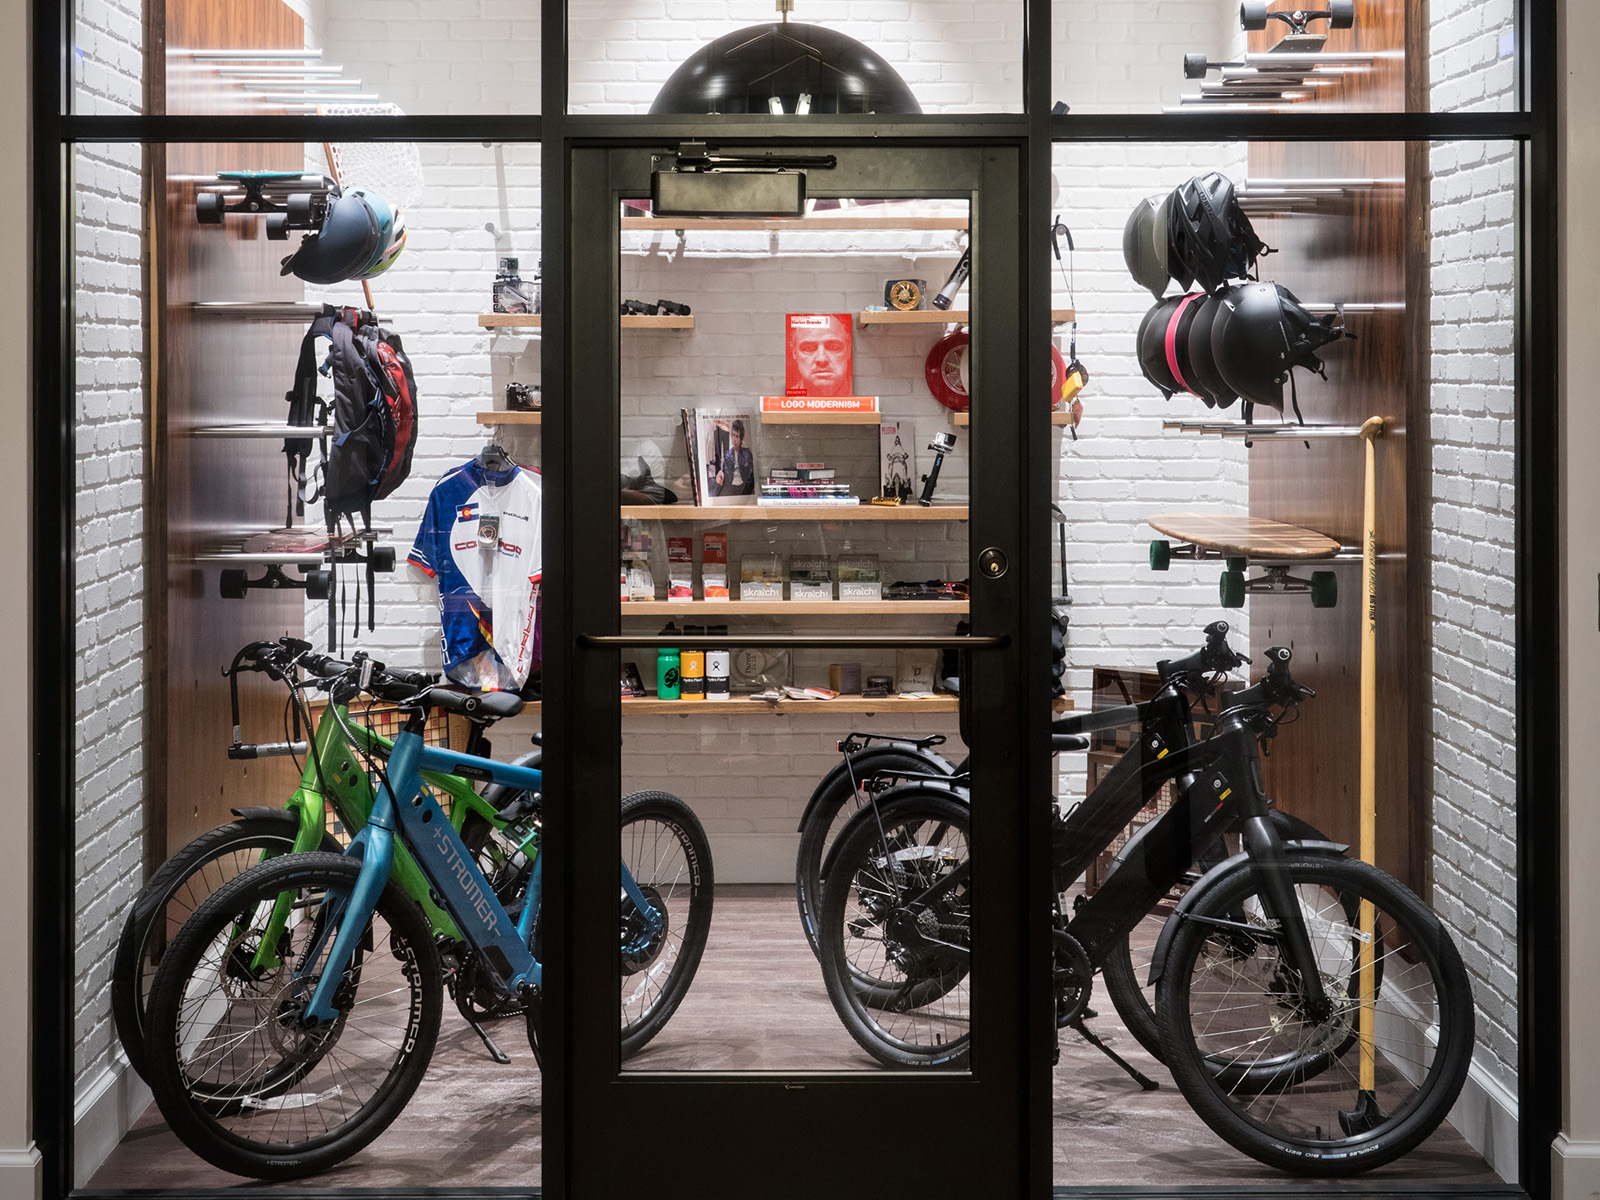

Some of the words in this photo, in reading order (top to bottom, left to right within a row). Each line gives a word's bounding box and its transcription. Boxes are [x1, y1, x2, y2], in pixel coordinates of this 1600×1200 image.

[781, 400, 805, 408] LOGO
[807, 400, 860, 408] MODERNISM
[743, 587, 776, 597] skratch
[794, 590, 826, 599] skratch
[843, 587, 874, 596] skratch
